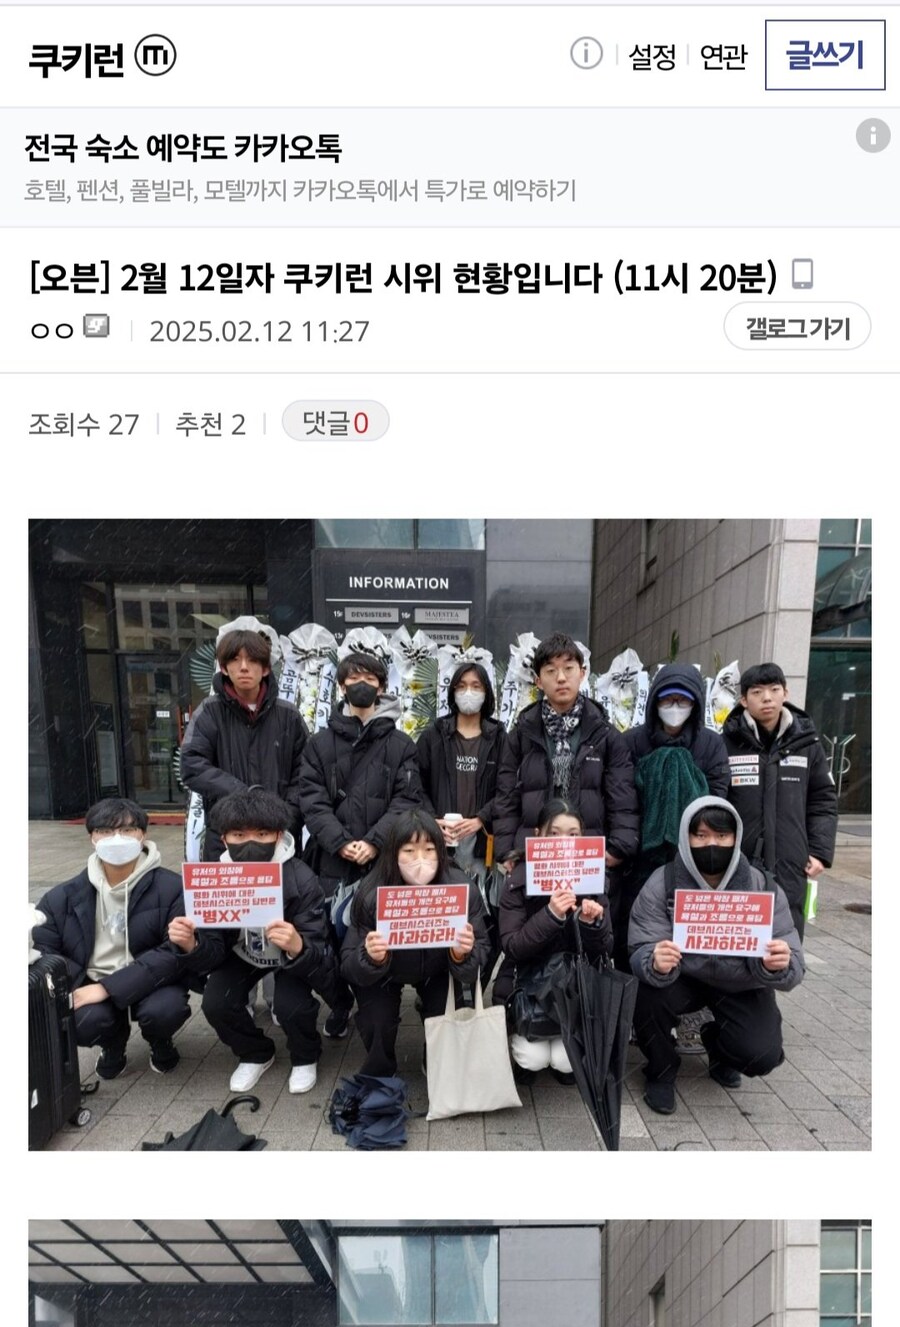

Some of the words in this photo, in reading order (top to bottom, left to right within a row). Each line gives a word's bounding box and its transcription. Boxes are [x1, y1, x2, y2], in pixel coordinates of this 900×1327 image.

[29, 43, 124, 79] 쿠키런
[629, 44, 676, 71] 설정
[700, 44, 748, 70] 연관
[786, 40, 863, 70] 글쓰기
[25, 134, 78, 163] 전국
[85, 134, 139, 163] 숙소
[147, 133, 228, 163] 예약도
[235, 134, 342, 164] 카카오톡
[24, 179, 71, 204] 호텔,
[77, 179, 124, 203] 펜션,
[130, 179, 198, 203] 풀빌라,
[204, 179, 287, 202] 모텔까지
[293, 179, 418, 202] 카카오톡에서
[425, 179, 487, 202] 특가로
[494, 179, 576, 202] 예약하기
[31, 260, 109, 294] [오븐]
[121, 262, 167, 294] 2월
[180, 262, 275, 294] 12일자
[284, 262, 372, 294] 쿠키런
[384, 262, 440, 294] 시위
[453, 262, 603, 295] 현황입니다
[615, 259, 688, 295] (11시
[700, 259, 776, 295] 20분)
[150, 320, 292, 342] 2025.02.12
[303, 321, 370, 343] 11:27
[29, 412, 101, 437] 조회수
[109, 414, 139, 435] 27
[175, 412, 222, 437] 추천
[232, 414, 246, 435] 2
[349, 576, 449, 589] INFORMATION
[193, 898, 250, 907] 데브시스터즈의
[388, 927, 456, 945] 사과하라!
[390, 918, 450, 930] 데브시스터즈는
[687, 925, 752, 935] 데브시스터즈는
[685, 935, 758, 951] 사과하라!
